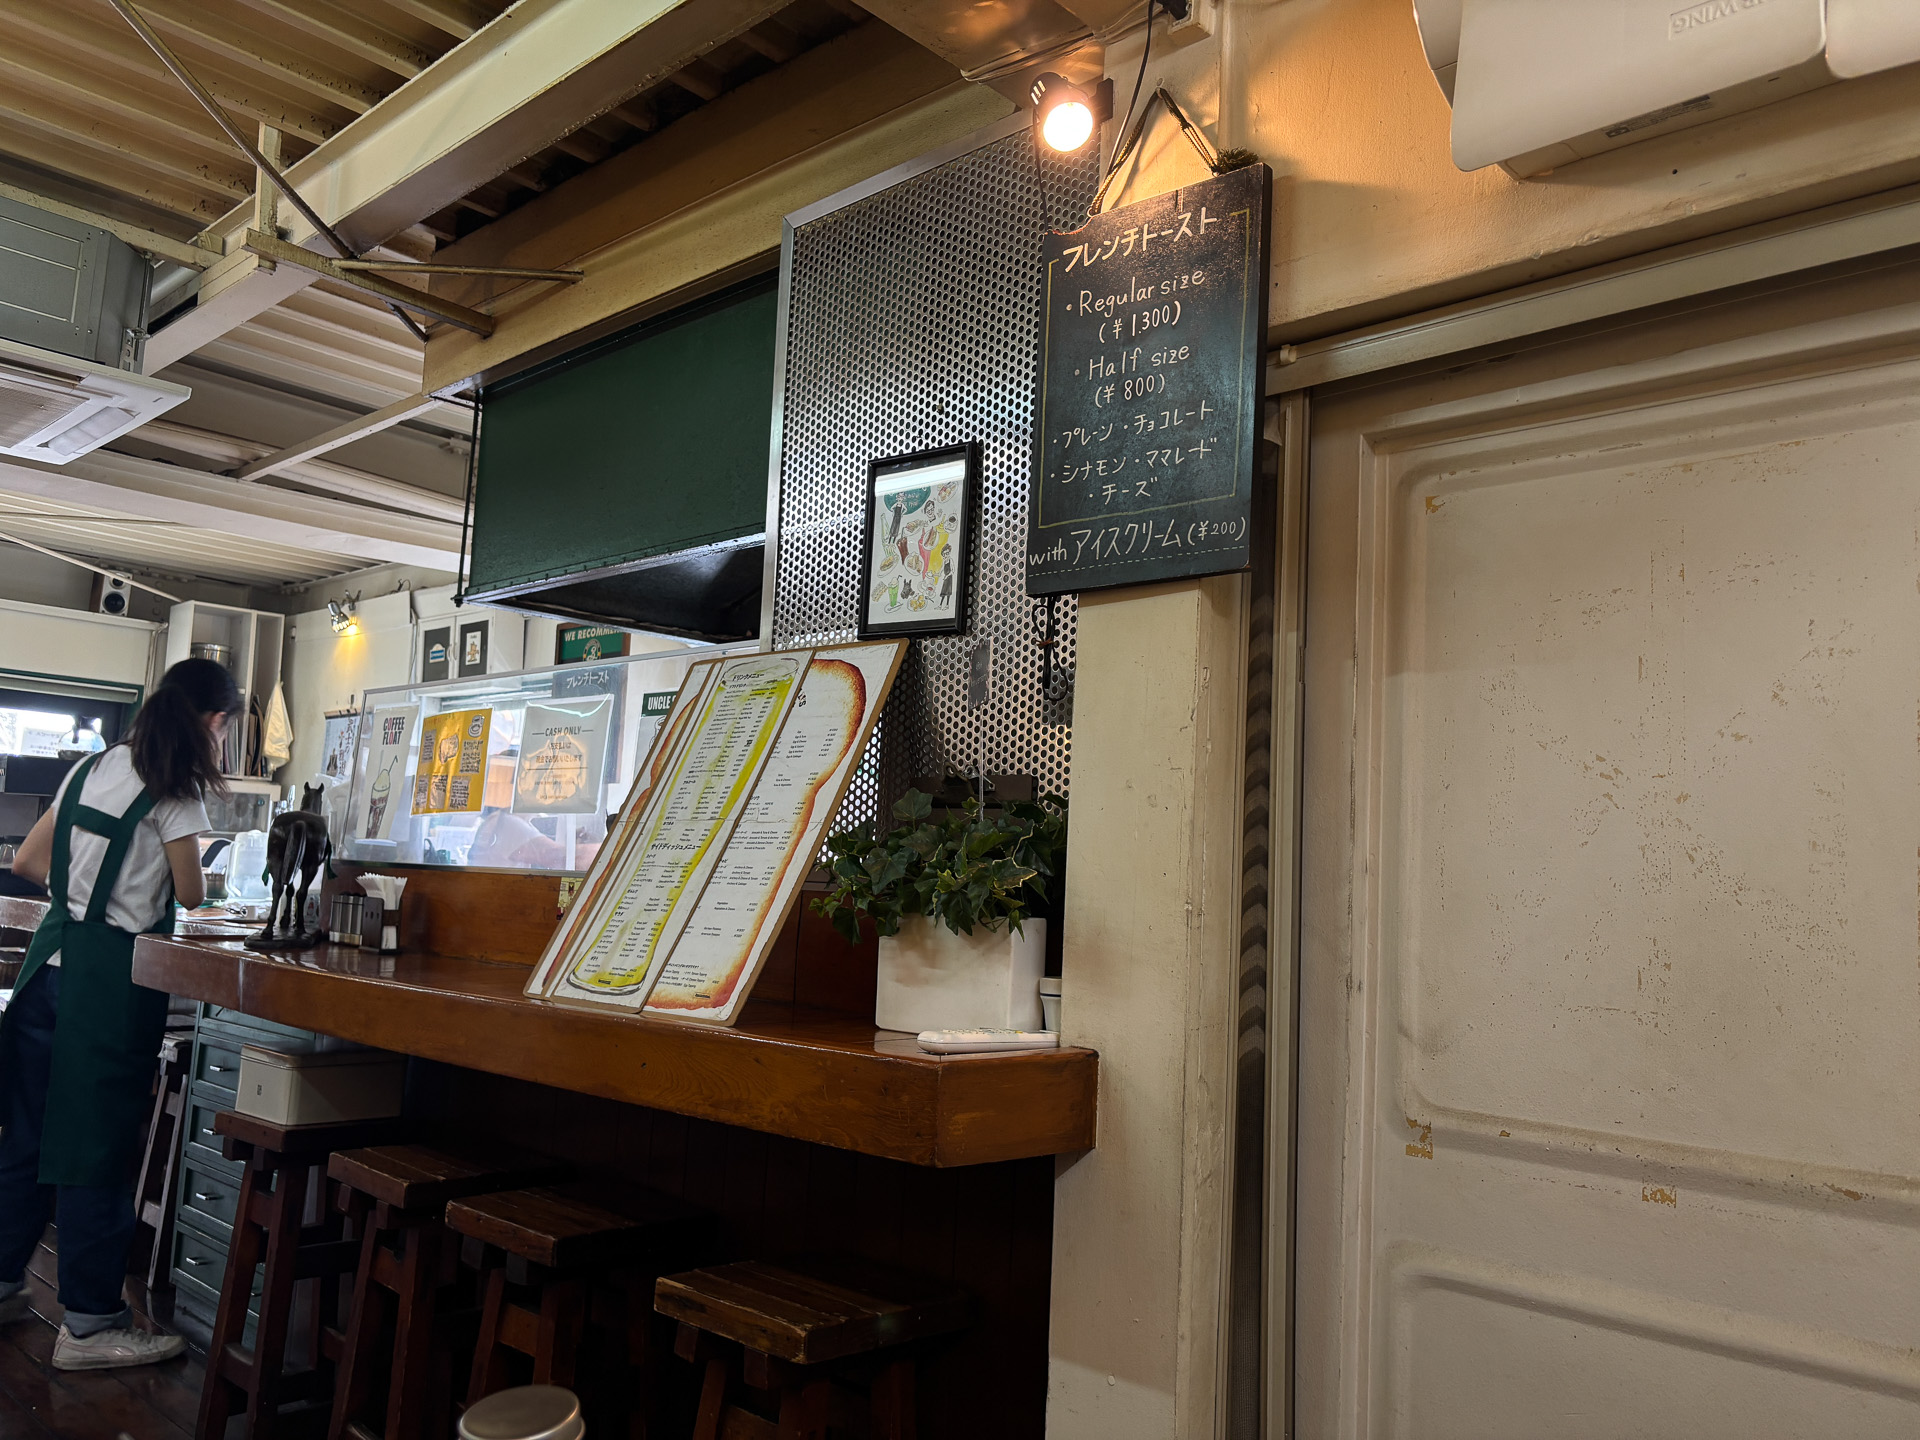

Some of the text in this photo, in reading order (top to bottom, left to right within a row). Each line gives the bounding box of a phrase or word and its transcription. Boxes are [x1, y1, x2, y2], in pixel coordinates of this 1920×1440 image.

[1062, 206, 1218, 272] フレンチトースト
[1079, 269, 1206, 318] Regular size
[1089, 345, 1190, 381] Half size
[1029, 516, 1247, 566] with アイスクリーム (¥200)
[564, 631, 576, 642] WE
[566, 669, 610, 689] フレンチトースト
[647, 695, 672, 711] UNCLE
[383, 716, 406, 732] COFFEE
[545, 726, 582, 737] CASH ONLY
[382, 731, 403, 746] FLOAT
